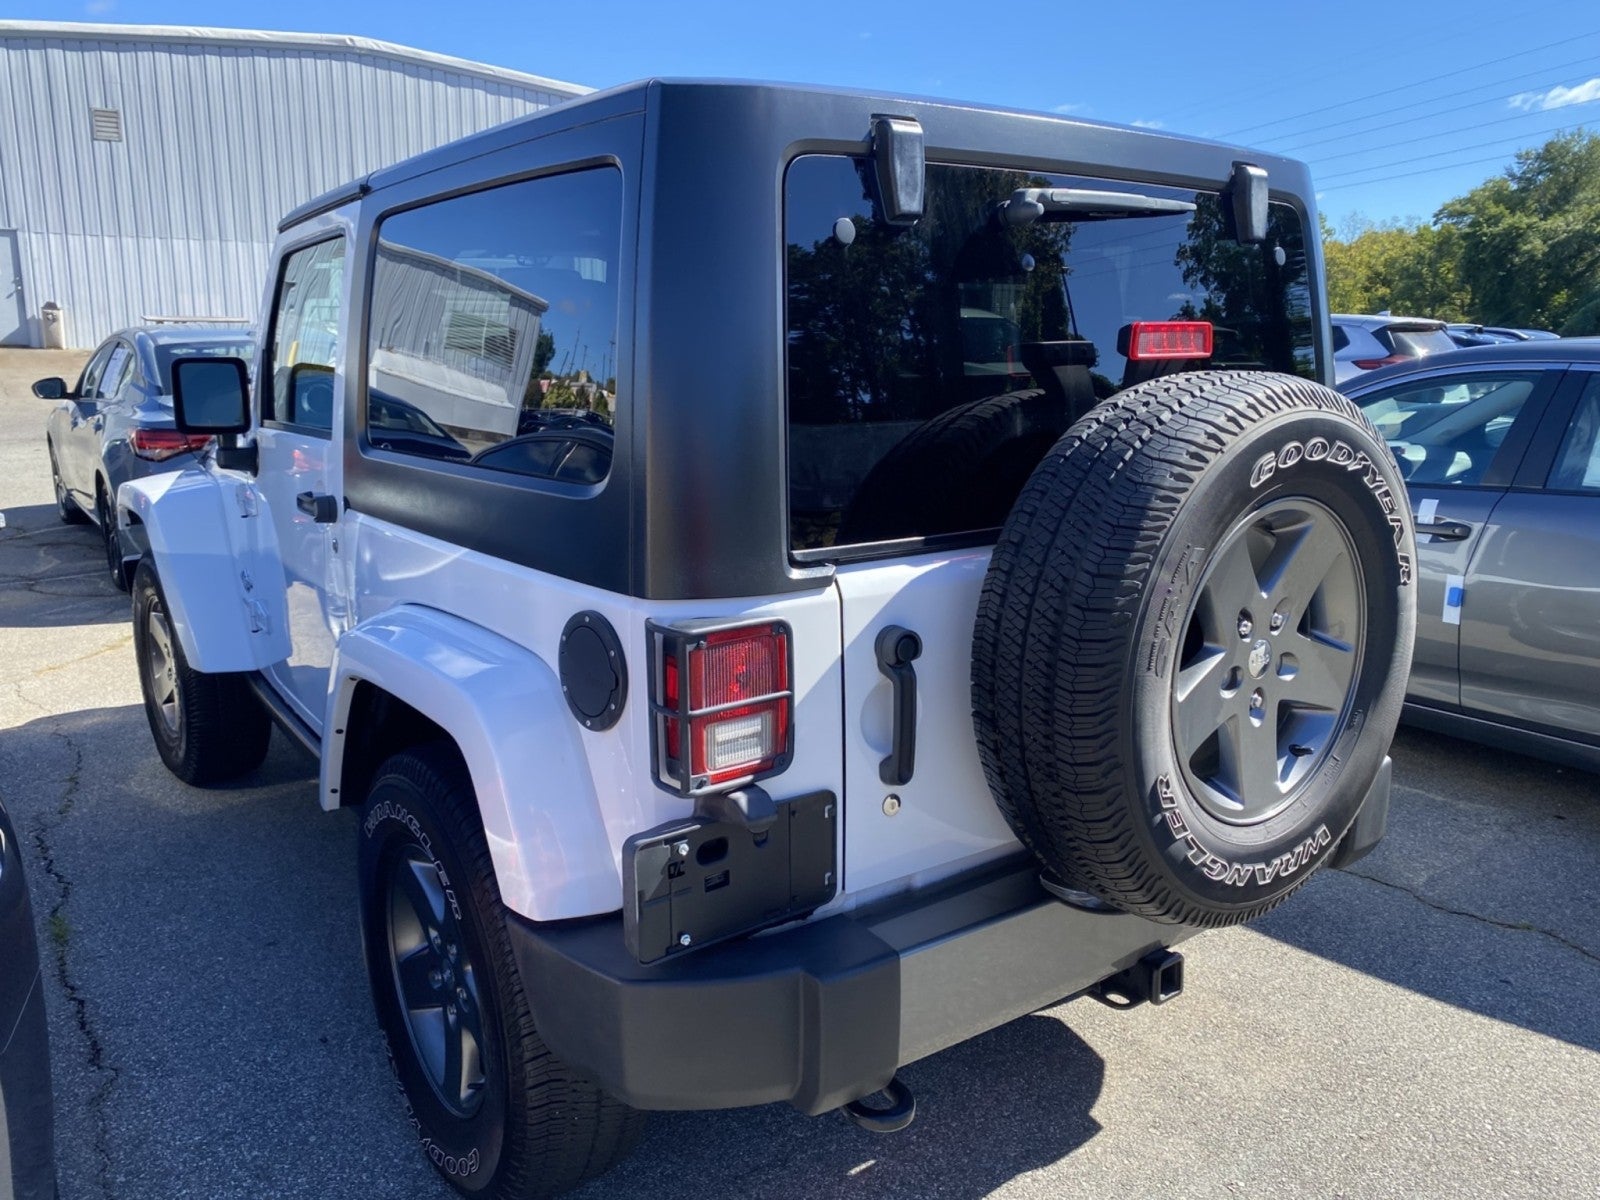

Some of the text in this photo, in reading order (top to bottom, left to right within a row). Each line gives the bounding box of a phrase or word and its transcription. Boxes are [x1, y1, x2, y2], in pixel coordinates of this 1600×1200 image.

[1250, 436, 1412, 587] GOODYEAR
[364, 801, 462, 920] WRANGLER
[1156, 775, 1332, 887] WRANGLER
